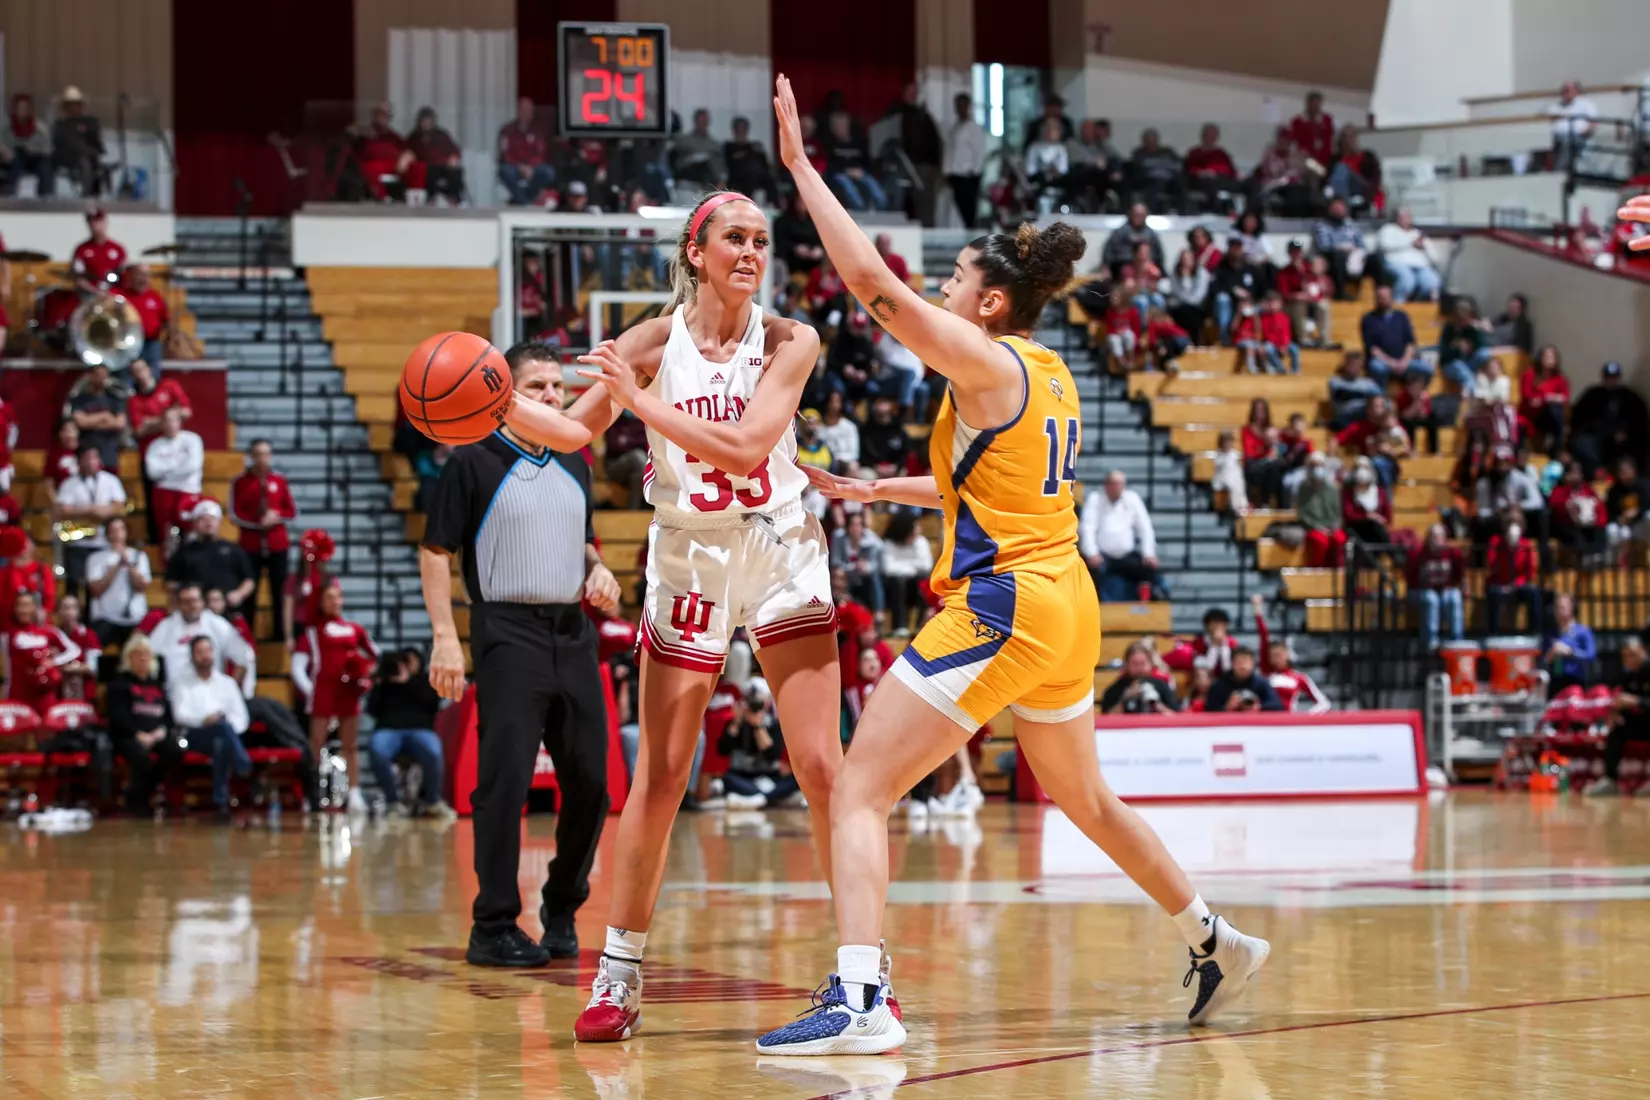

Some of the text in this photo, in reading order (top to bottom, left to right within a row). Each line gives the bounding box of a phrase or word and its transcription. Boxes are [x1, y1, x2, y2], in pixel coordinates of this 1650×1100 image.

[582, 69, 645, 123] 24
[672, 394, 750, 423] NDIAN
[685, 451, 773, 513] 33
[1041, 416, 1078, 497] 14
